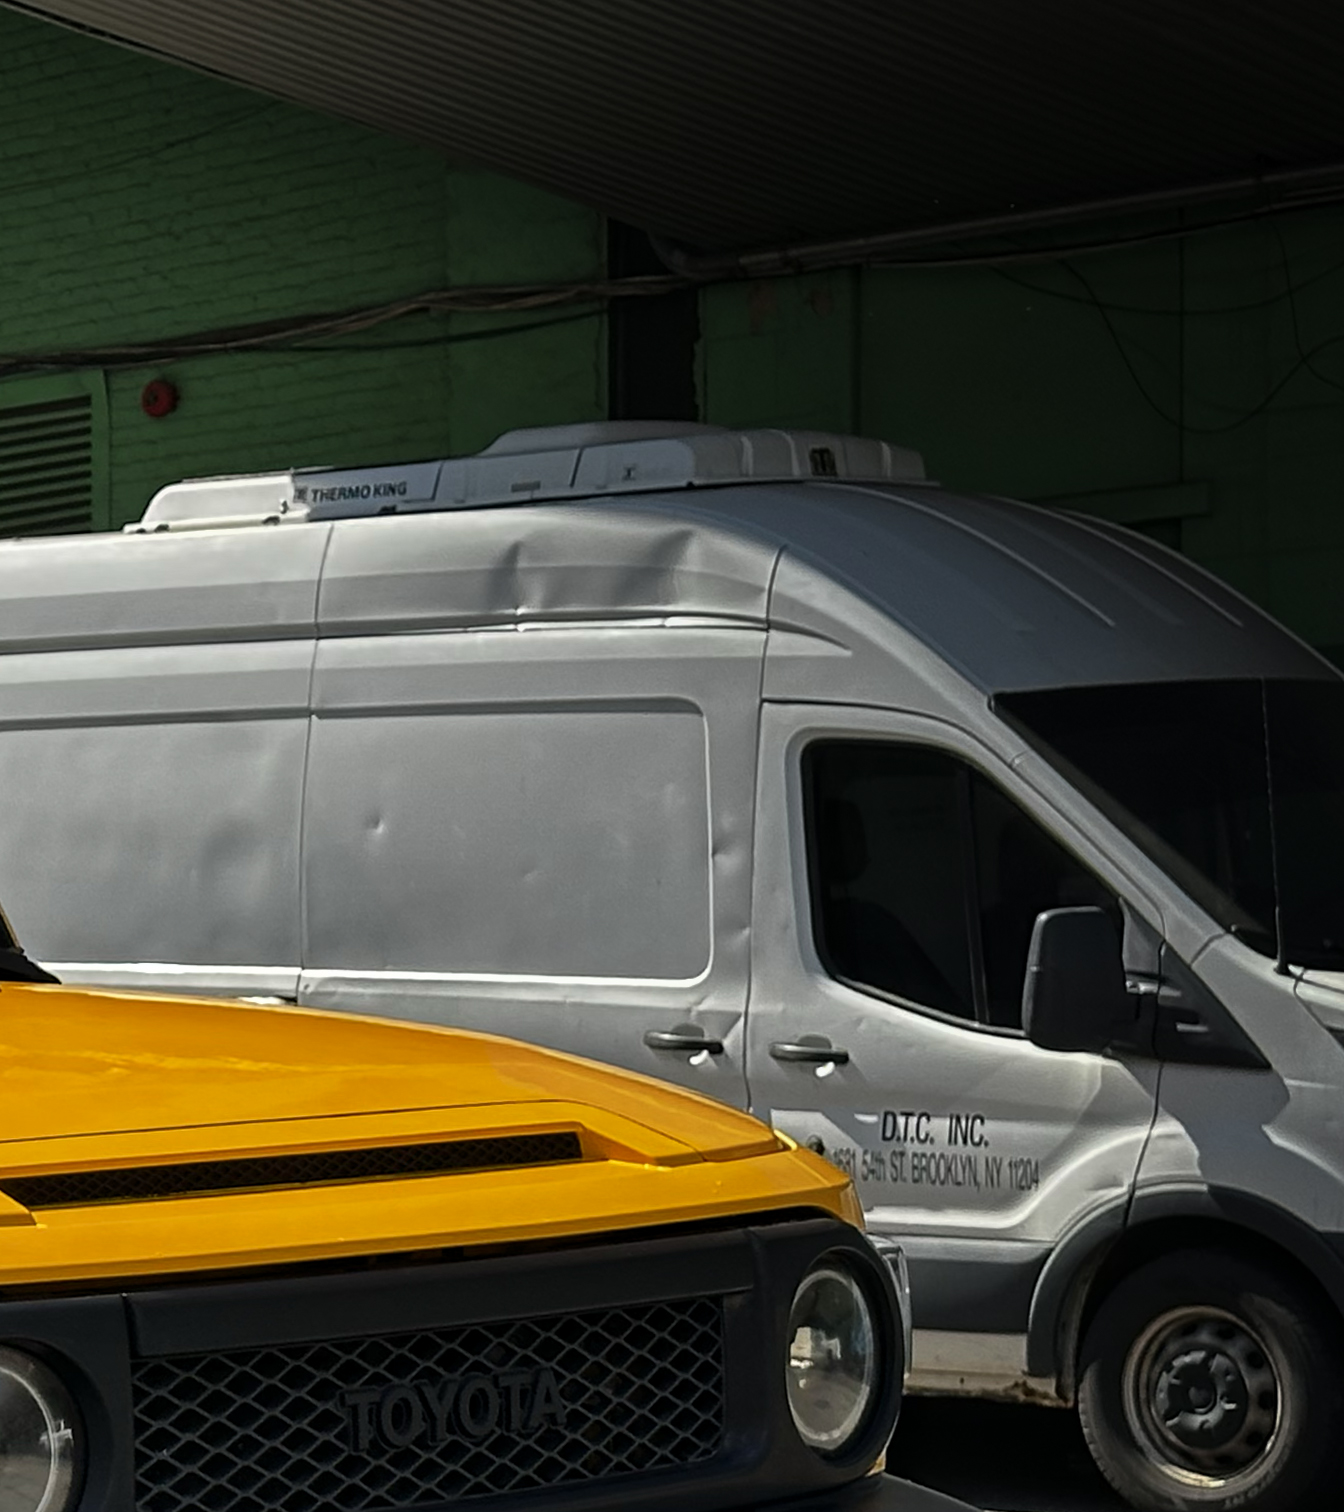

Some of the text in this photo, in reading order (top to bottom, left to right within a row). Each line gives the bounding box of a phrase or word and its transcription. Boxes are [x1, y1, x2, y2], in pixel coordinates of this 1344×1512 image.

[311, 481, 407, 502] THERMO KING
[881, 1110, 990, 1147] D.T.C. INC.
[911, 1152, 981, 1192] BROOKLYN,
[985, 1156, 1003, 1188] NY
[1008, 1157, 1040, 1191] 11204
[338, 1365, 566, 1455] TOYOTA
